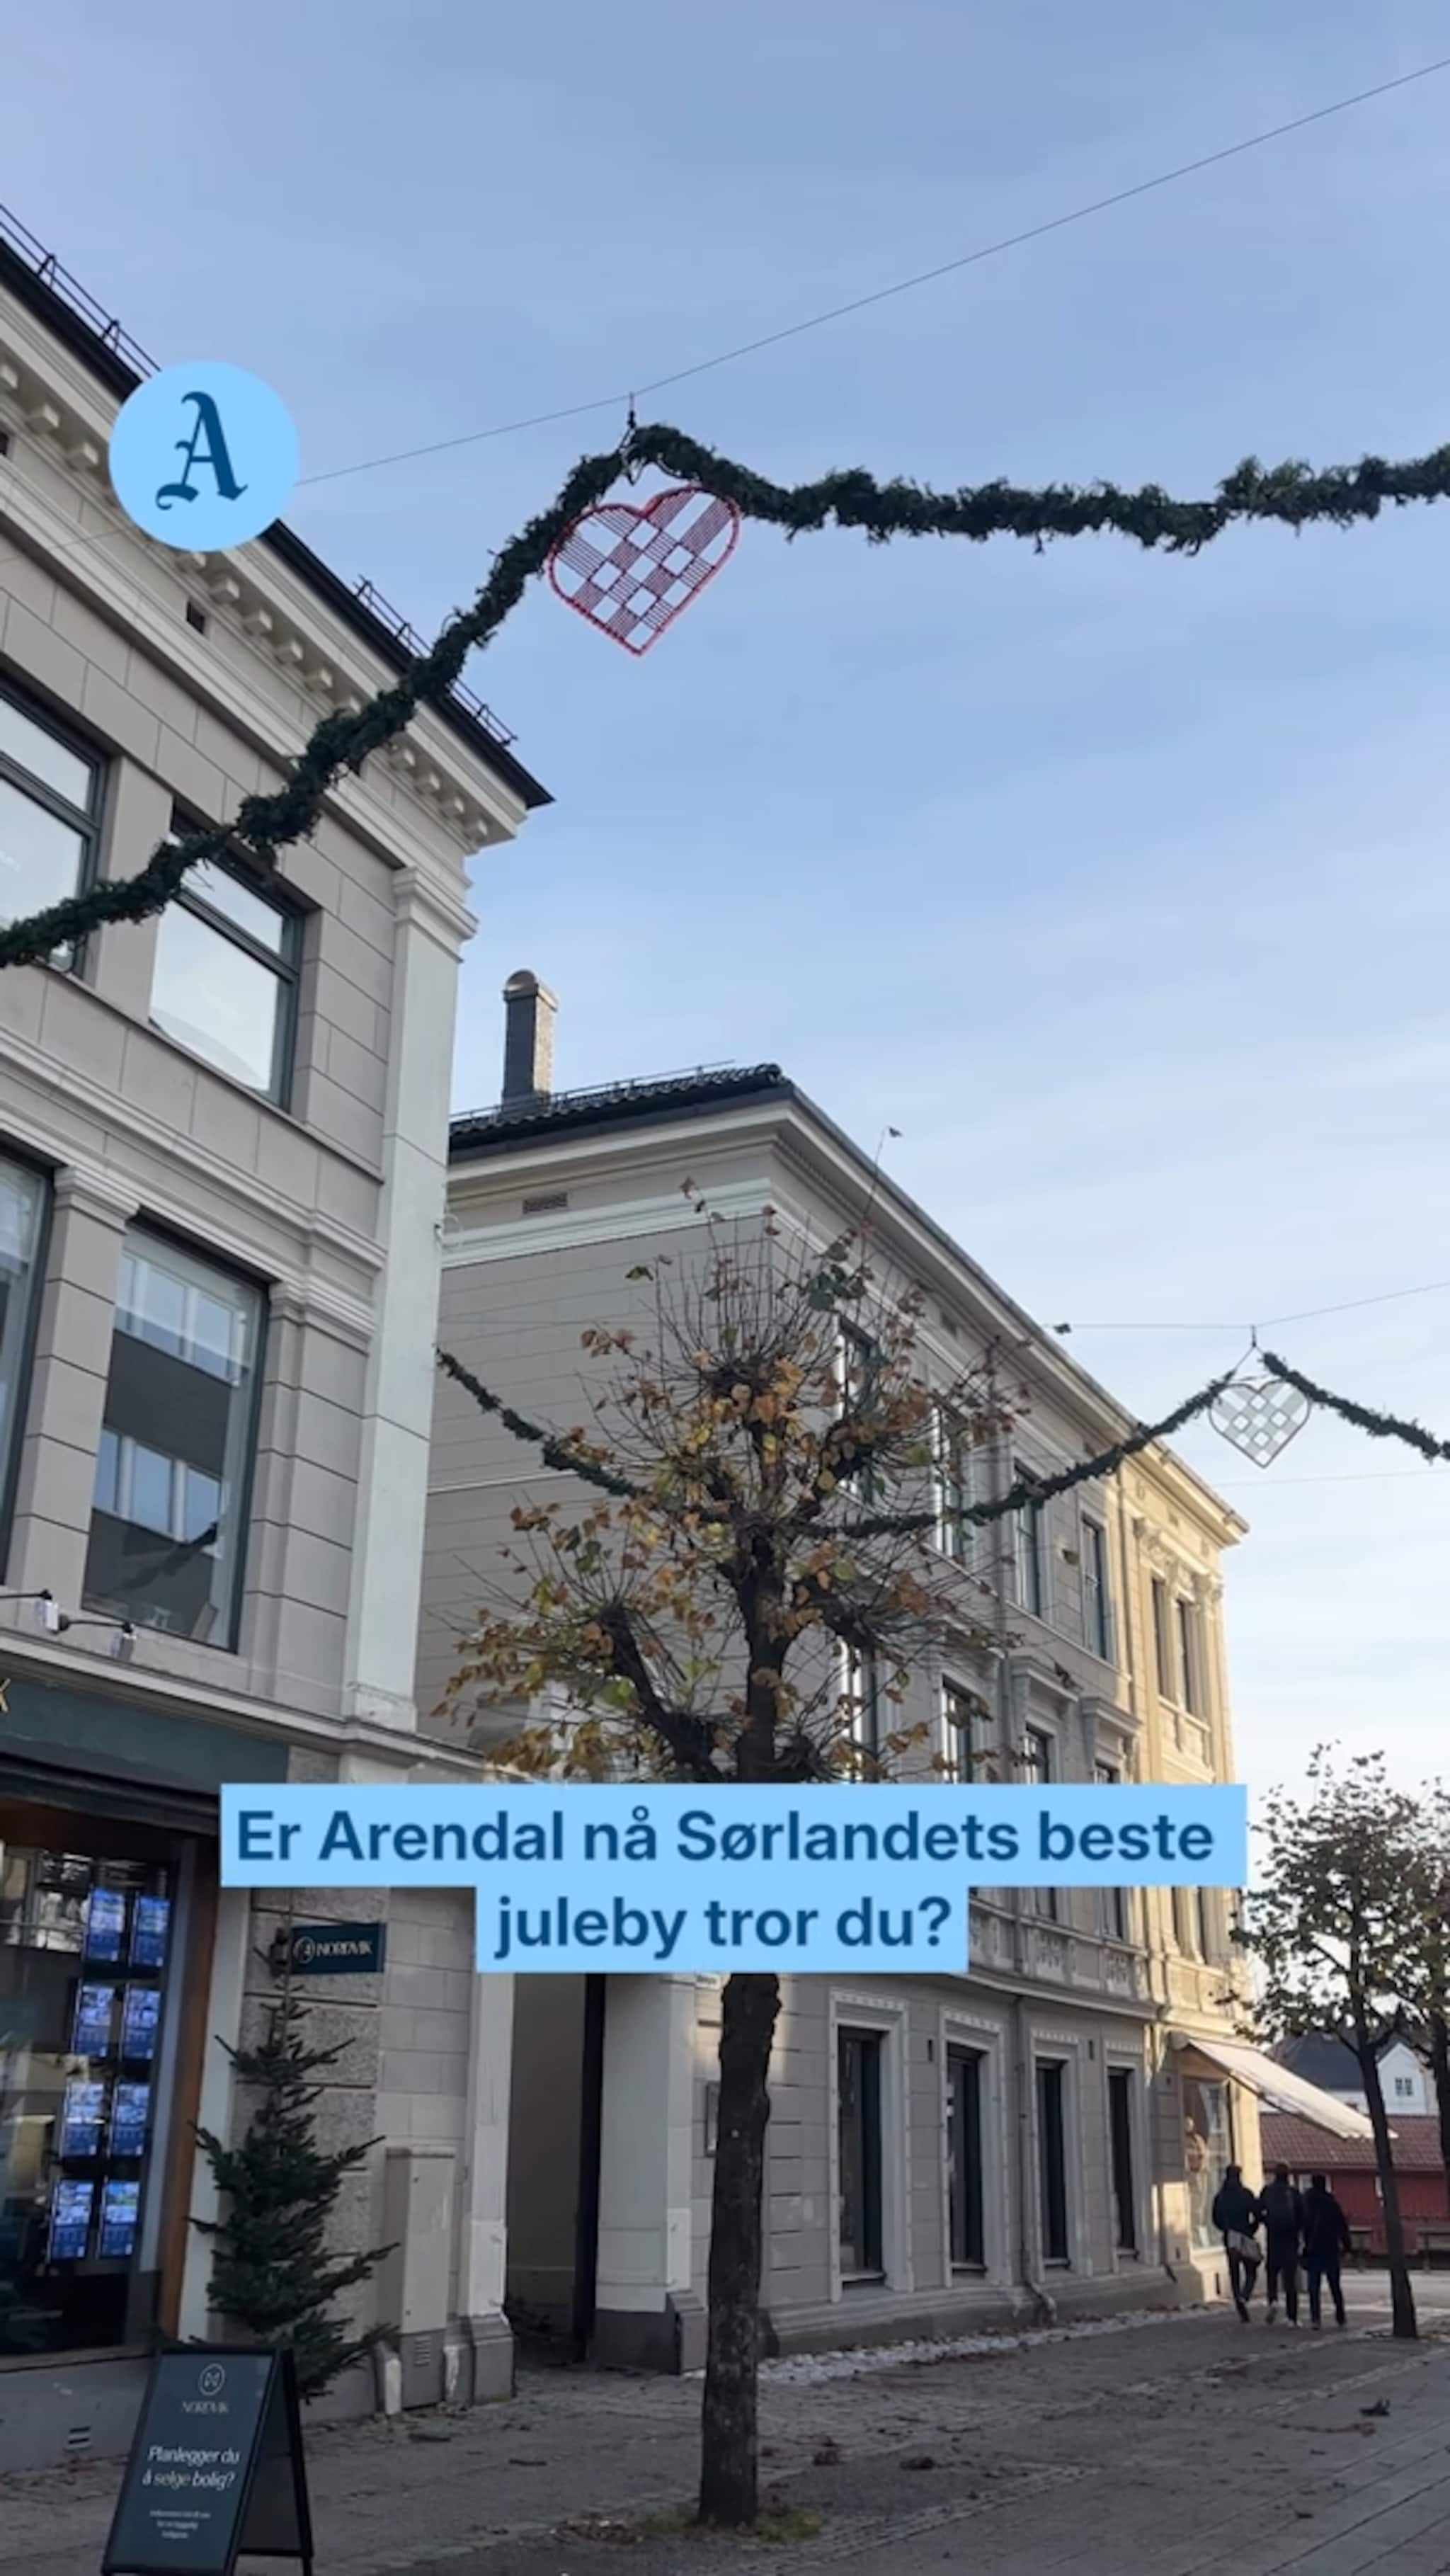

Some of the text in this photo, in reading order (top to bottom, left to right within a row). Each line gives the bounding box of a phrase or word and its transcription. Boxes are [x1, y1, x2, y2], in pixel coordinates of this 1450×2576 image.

[148, 2445, 240, 2466] Planlegger du
[153, 2470, 190, 2490] selge
[192, 2470, 236, 2491] bolig?
